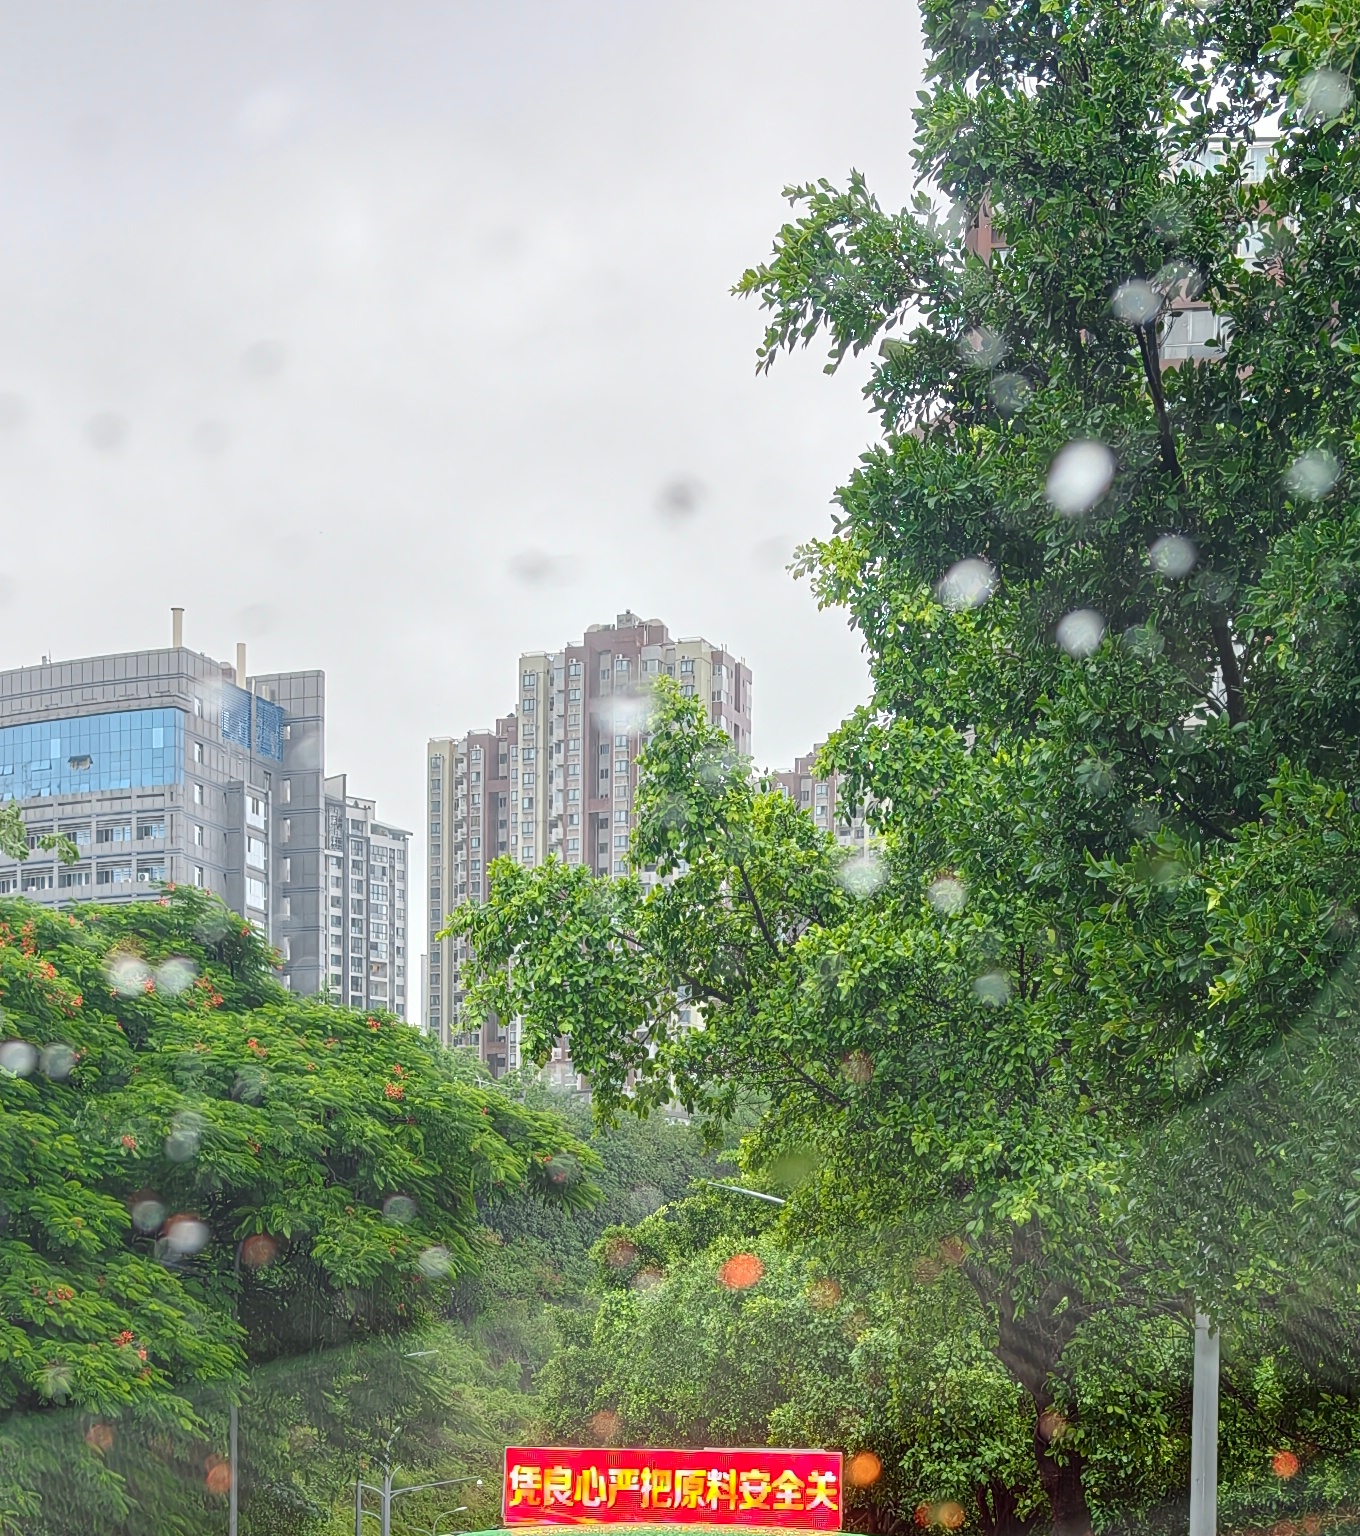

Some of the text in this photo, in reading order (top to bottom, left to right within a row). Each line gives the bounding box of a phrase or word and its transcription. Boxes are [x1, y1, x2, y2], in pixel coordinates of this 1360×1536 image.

[509, 1464, 839, 1511] 凭良心严把原料安全关
